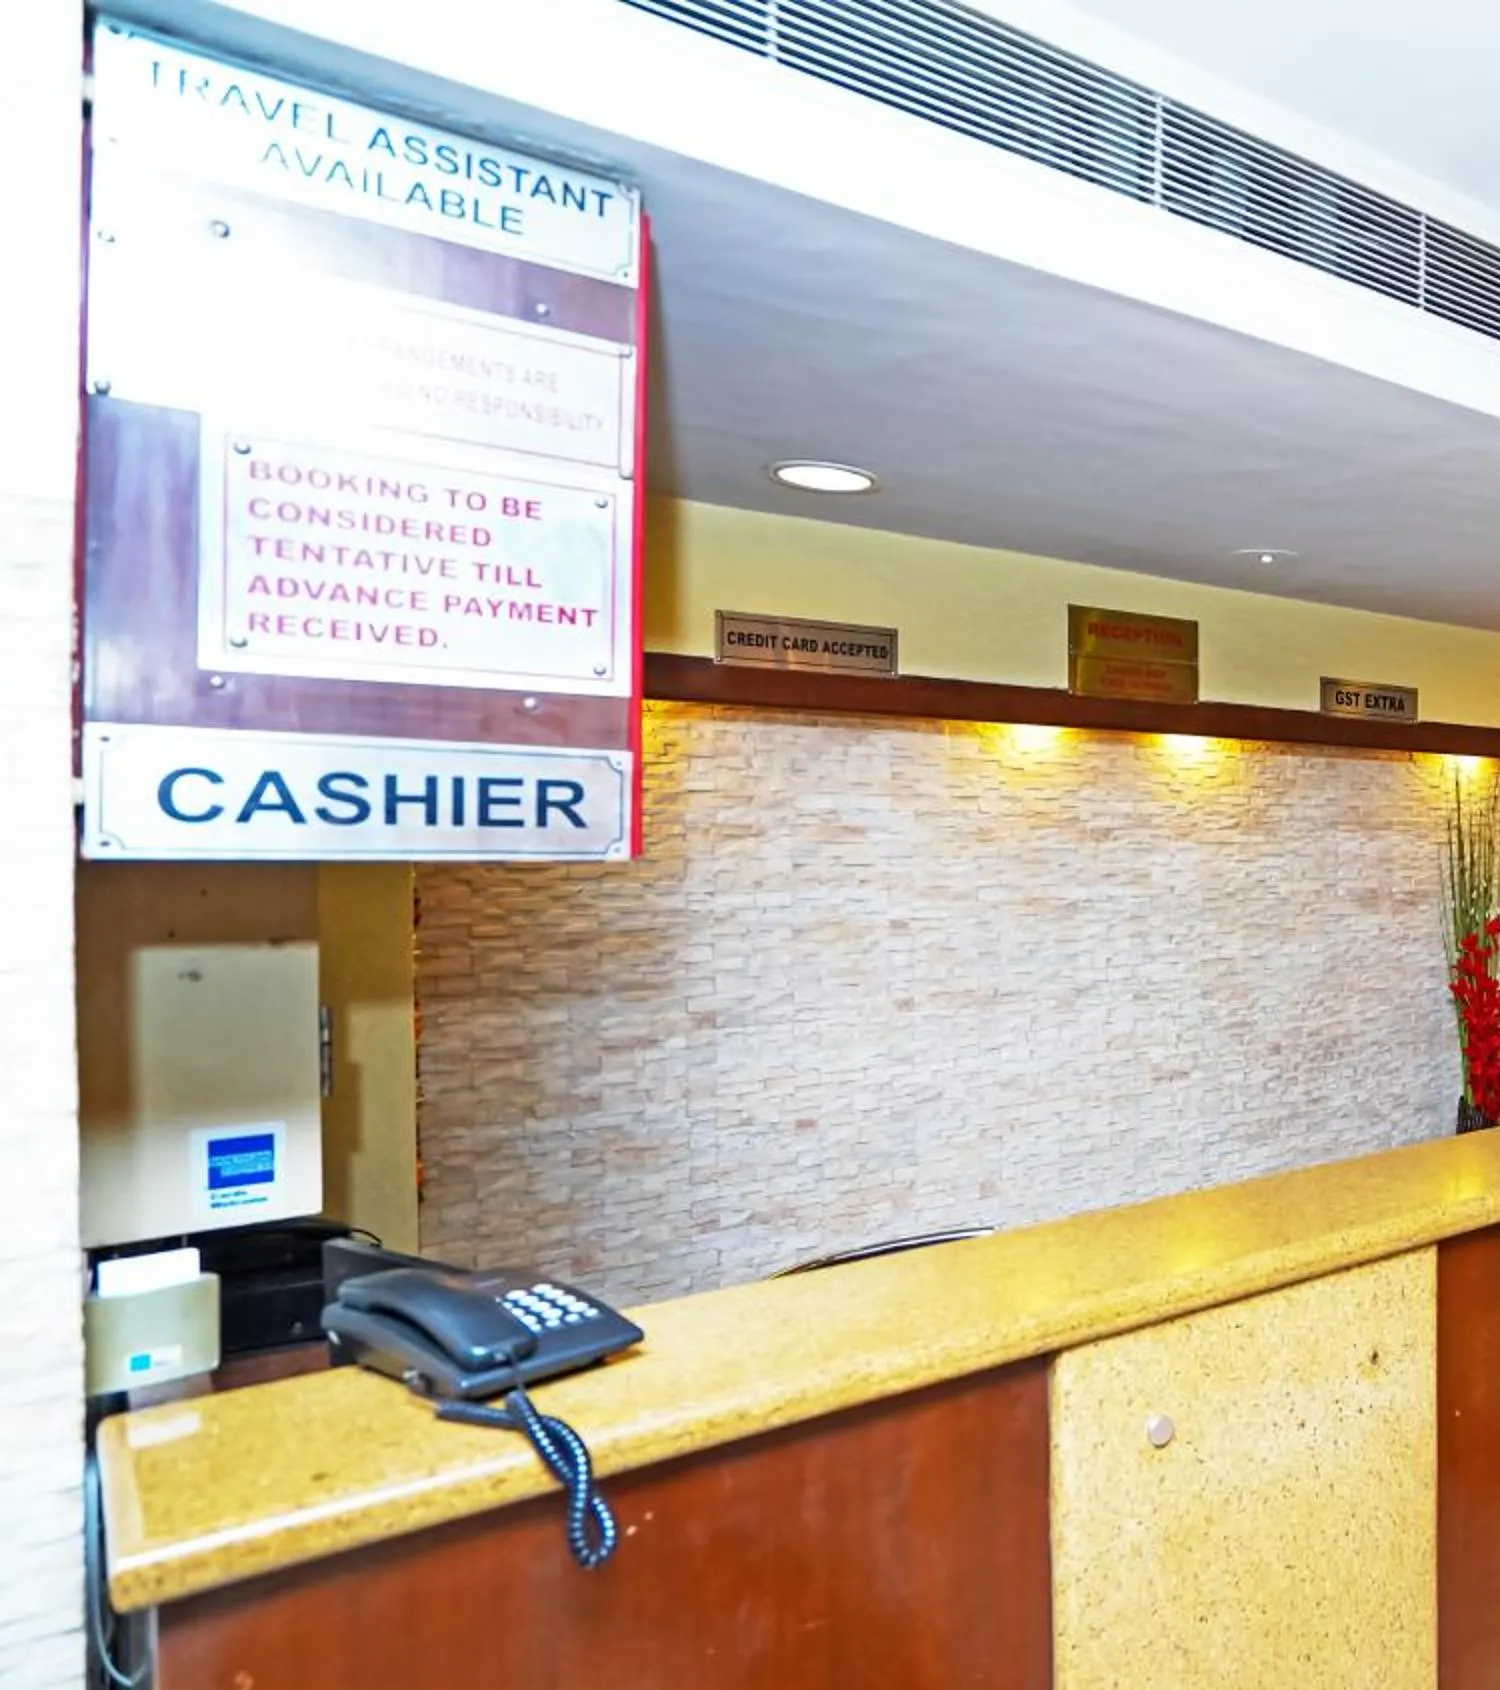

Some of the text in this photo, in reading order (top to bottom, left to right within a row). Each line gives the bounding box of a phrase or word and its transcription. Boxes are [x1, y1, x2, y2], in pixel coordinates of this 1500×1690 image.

[148, 60, 613, 218] TRAVEL ASSISTANT
[260, 143, 525, 236] AVAILABLE
[522, 367, 560, 394] ARE
[453, 388, 605, 431] RESPONSIBILITY
[248, 459, 544, 521] BOOKING TO BE
[247, 497, 492, 548] CONSIDERED
[248, 535, 543, 589] TENTATIVE TILL
[247, 574, 599, 629] ADVANCE PAYMENT
[248, 612, 449, 649] RECEIVED.
[727, 631, 889, 660] CREDIT CARD ACCEPTED
[1335, 690, 1405, 712] GST EXTRA
[156, 767, 590, 830] CASHIER
